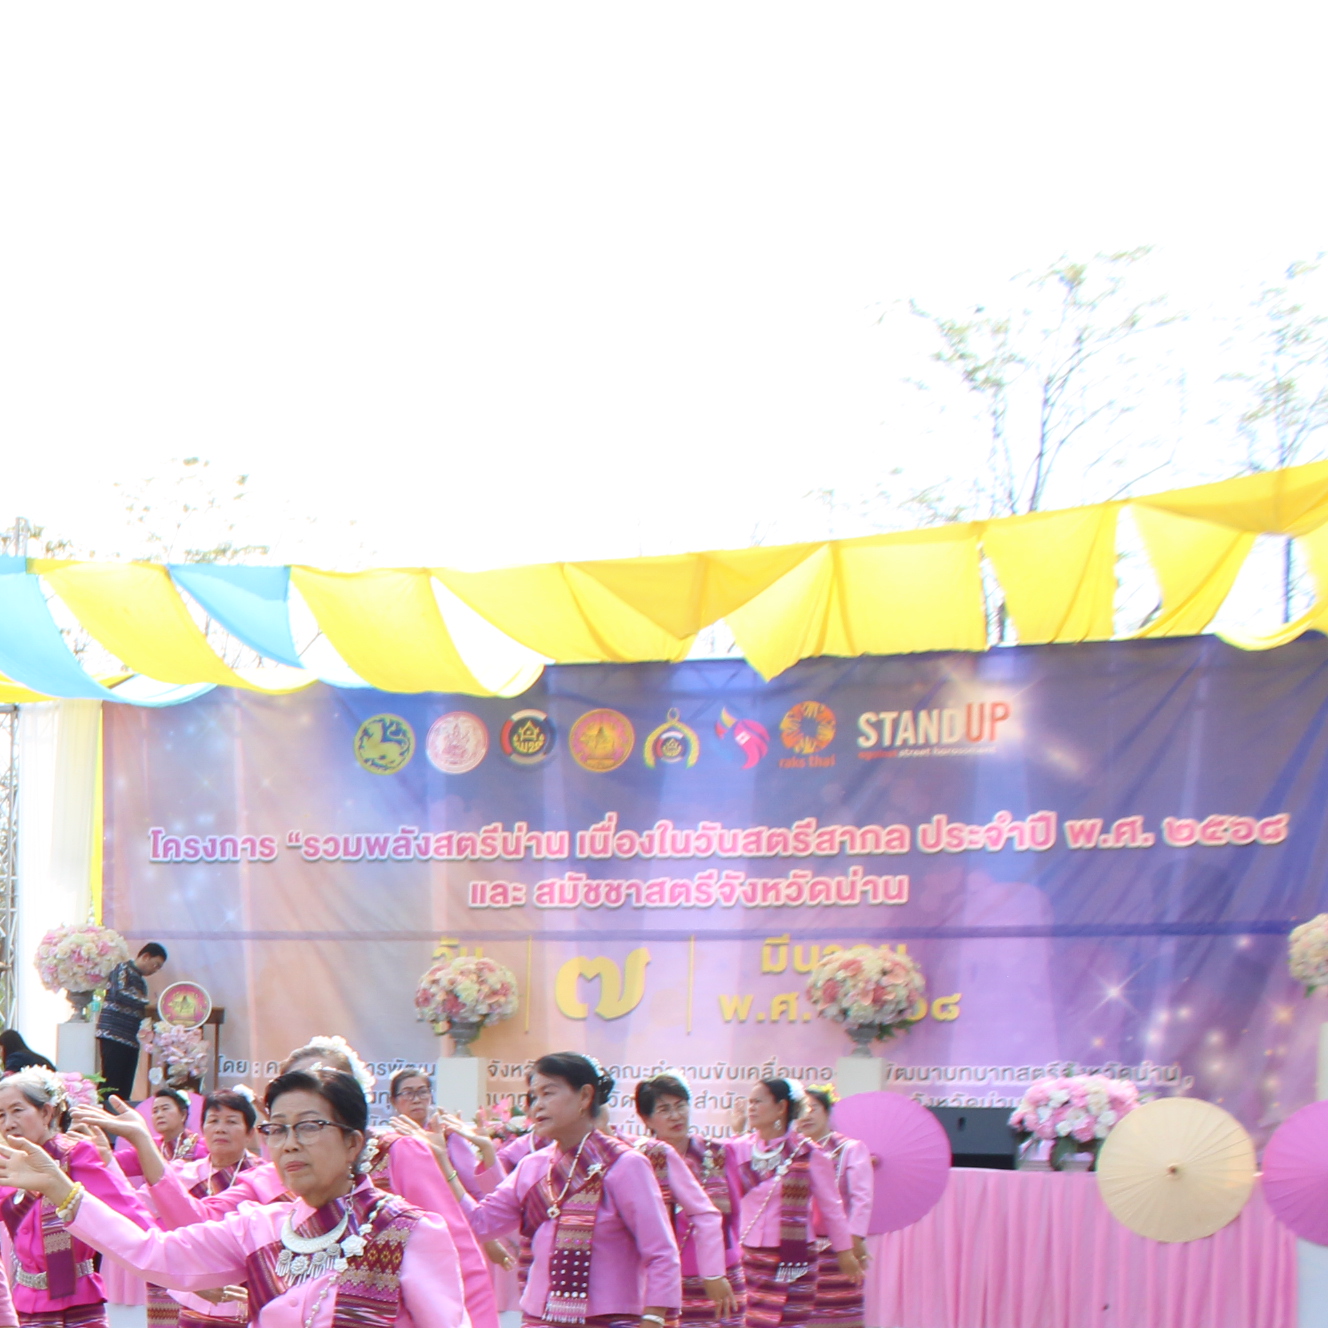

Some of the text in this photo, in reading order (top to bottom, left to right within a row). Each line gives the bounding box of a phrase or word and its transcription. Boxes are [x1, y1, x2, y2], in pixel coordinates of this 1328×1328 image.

[149, 827, 276, 862] โครงการ
[576, 811, 911, 859] เนื่องในวันสตรีสากล
[918, 809, 1057, 853] ประจำปี
[1064, 815, 1155, 849] พ.ศ.
[1161, 812, 1290, 848] ๒๕๖๘
[469, 866, 910, 908] และ สมัชชาสตรีจังหวัดน่าน
[555, 947, 651, 1021] ๗
[718, 990, 812, 1022] พ.ศ.
